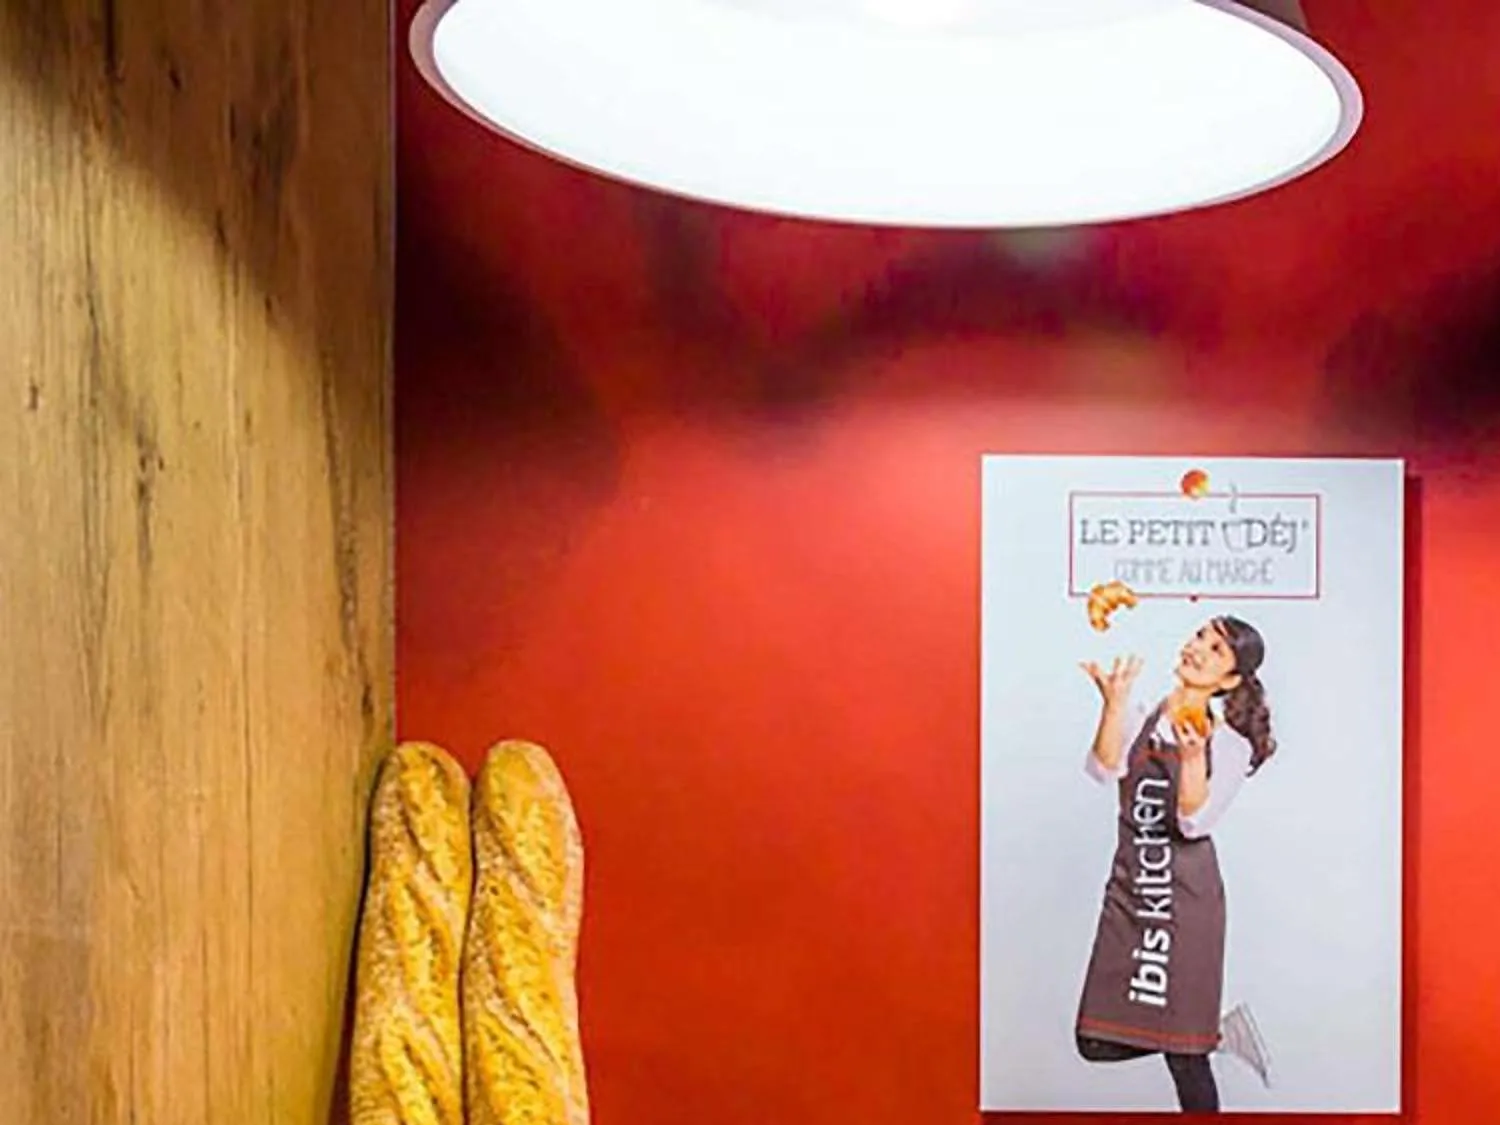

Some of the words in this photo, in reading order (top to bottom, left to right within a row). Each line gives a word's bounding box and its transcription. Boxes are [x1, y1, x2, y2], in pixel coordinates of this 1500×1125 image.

[1081, 519, 1119, 545] LE
[1128, 519, 1214, 546] PETIT
[1133, 776, 1173, 920] kitchen
[1129, 926, 1171, 1007] ibis
